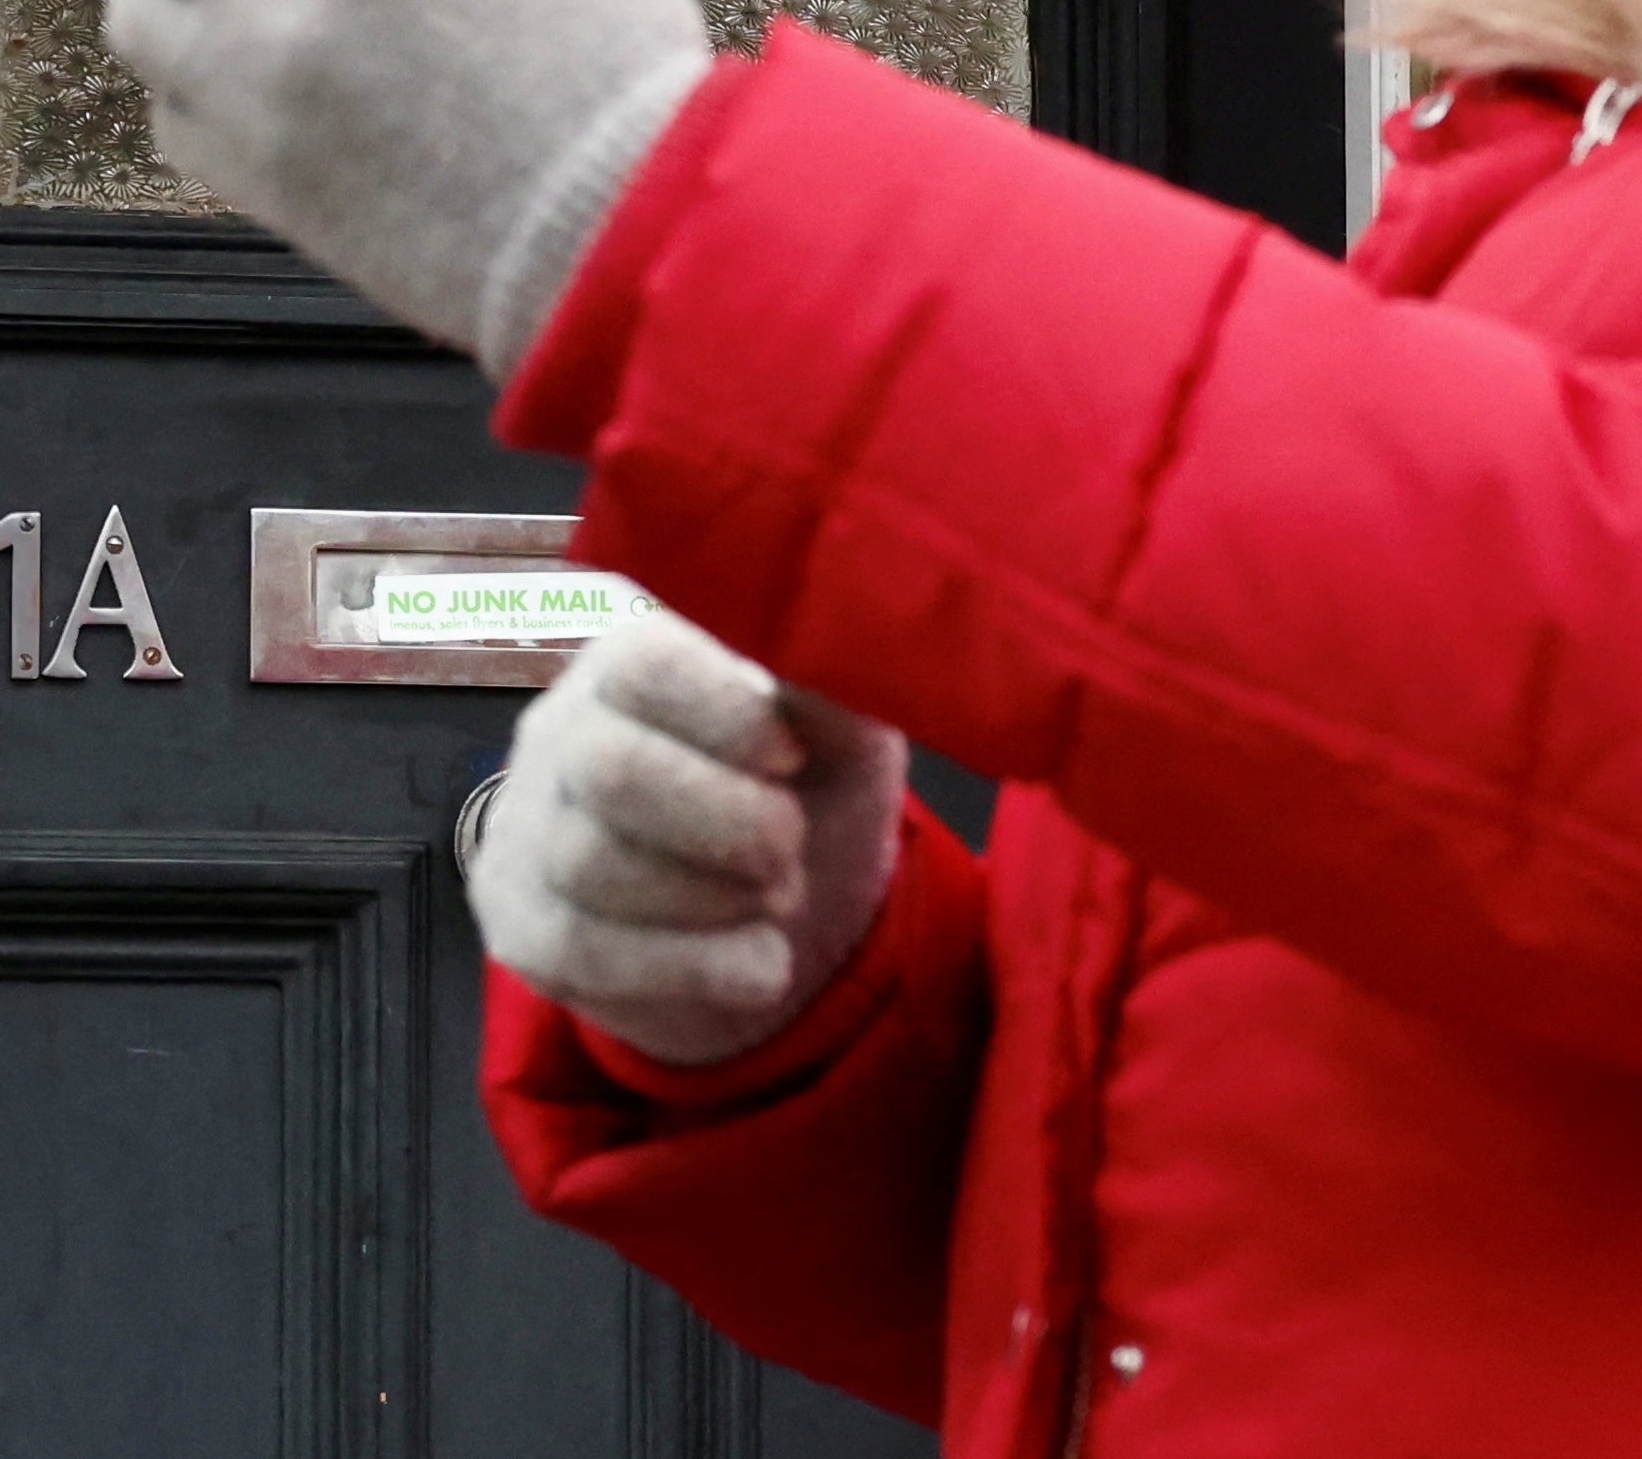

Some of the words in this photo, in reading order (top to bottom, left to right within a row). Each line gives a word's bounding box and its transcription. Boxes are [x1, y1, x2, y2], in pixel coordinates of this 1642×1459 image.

[387, 590, 436, 614] NO
[446, 589, 528, 613] JUNK
[540, 589, 613, 613] MAIL
[389, 618, 435, 631] (menus,
[439, 617, 468, 630] sales
[472, 616, 504, 631] flyers
[509, 617, 519, 629] &
[522, 616, 572, 630] business
